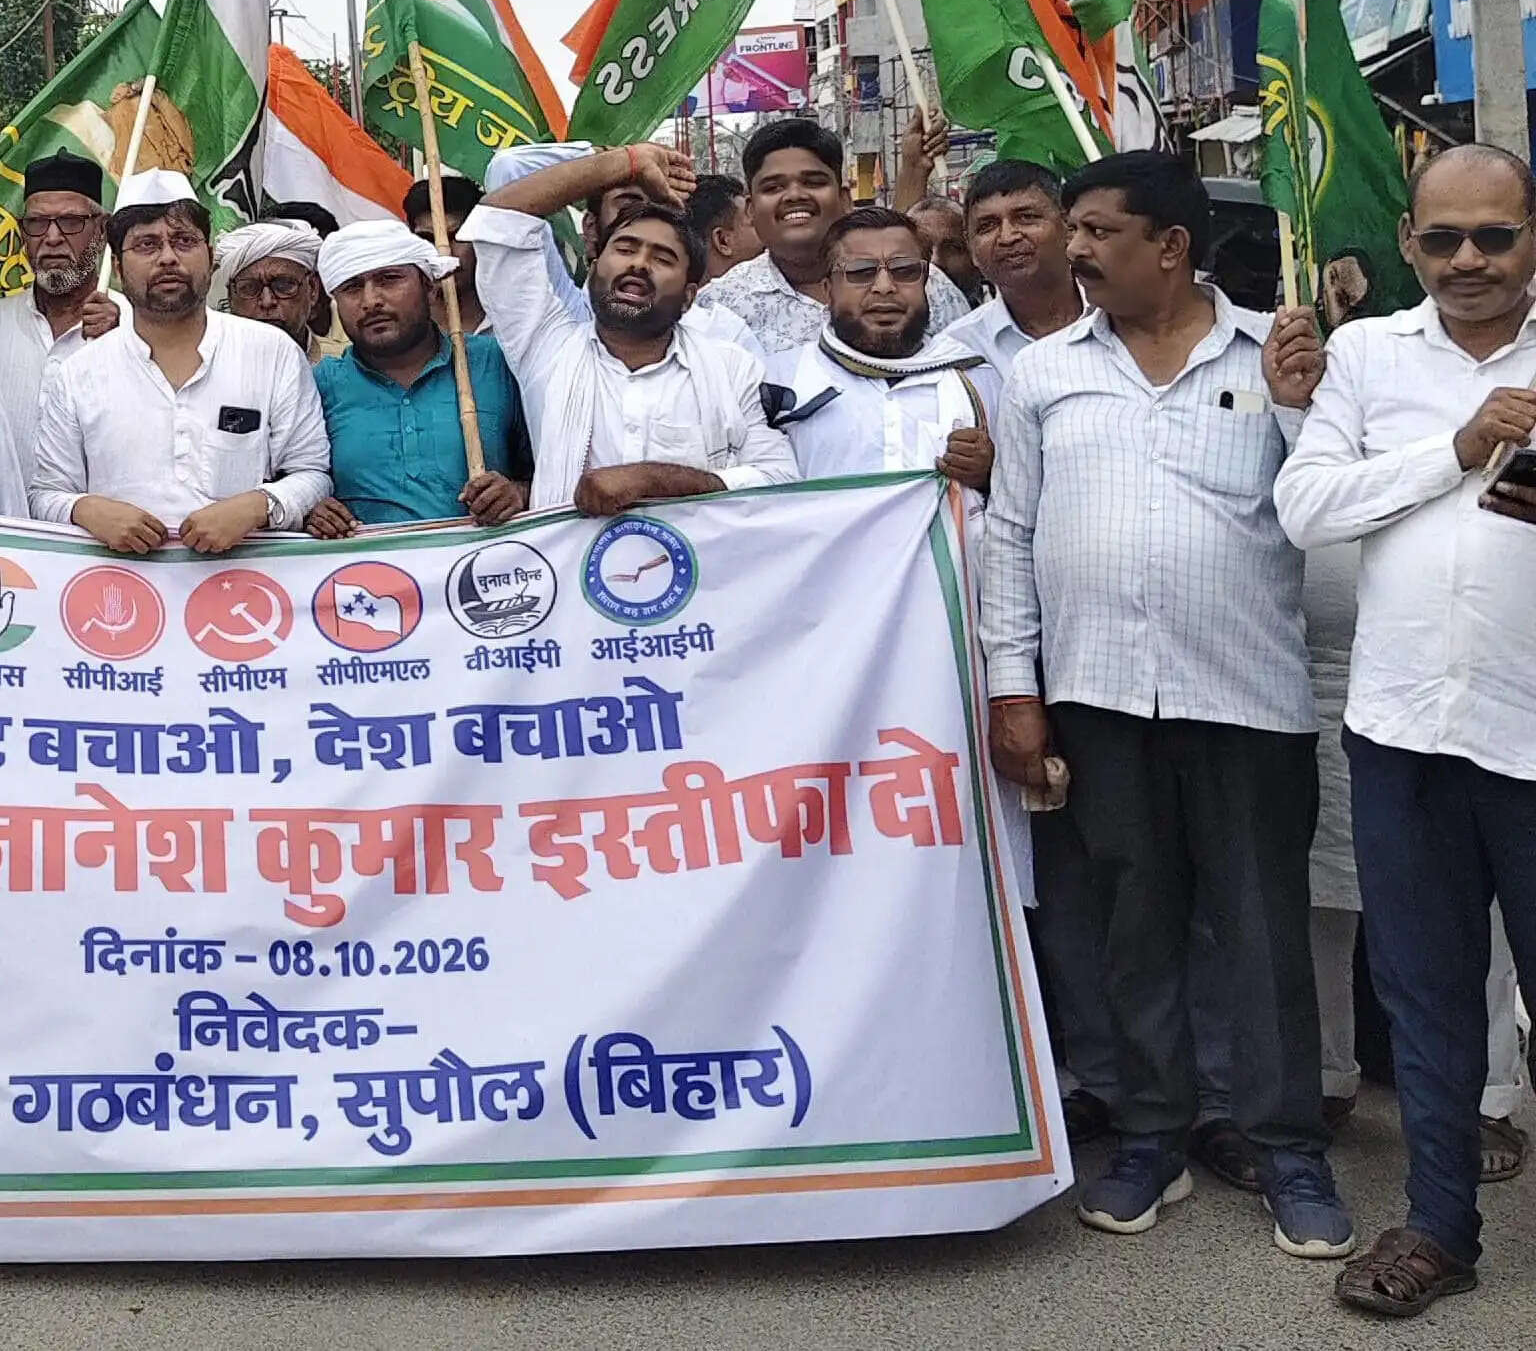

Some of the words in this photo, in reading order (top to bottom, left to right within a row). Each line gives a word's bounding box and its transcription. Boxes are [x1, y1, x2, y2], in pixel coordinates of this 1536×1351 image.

[476, 573, 512, 593] चुनाव
[464, 638, 561, 673] वीआईपी
[590, 623, 715, 663] आईआईपी
[62, 662, 164, 695] सीपीआई
[199, 664, 287, 692] सीपीएम
[316, 656, 431, 686] सीपीएमएल
[22, 707, 292, 784] बचाओ,
[308, 703, 436, 771] देश
[448, 677, 684, 764] बचाओ
[248, 805, 504, 927] कुमार
[519, 761, 853, 900] इस्तीफा
[859, 728, 963, 847] दो
[80, 926, 226, 975] दिनांक
[267, 936, 491, 978] 08.10.2026
[174, 991, 418, 1054] निवेदक-
[9, 1053, 319, 1143] गठबंधन,
[331, 1049, 548, 1157] सुपौल
[562, 1025, 813, 1141] (बिहार)
